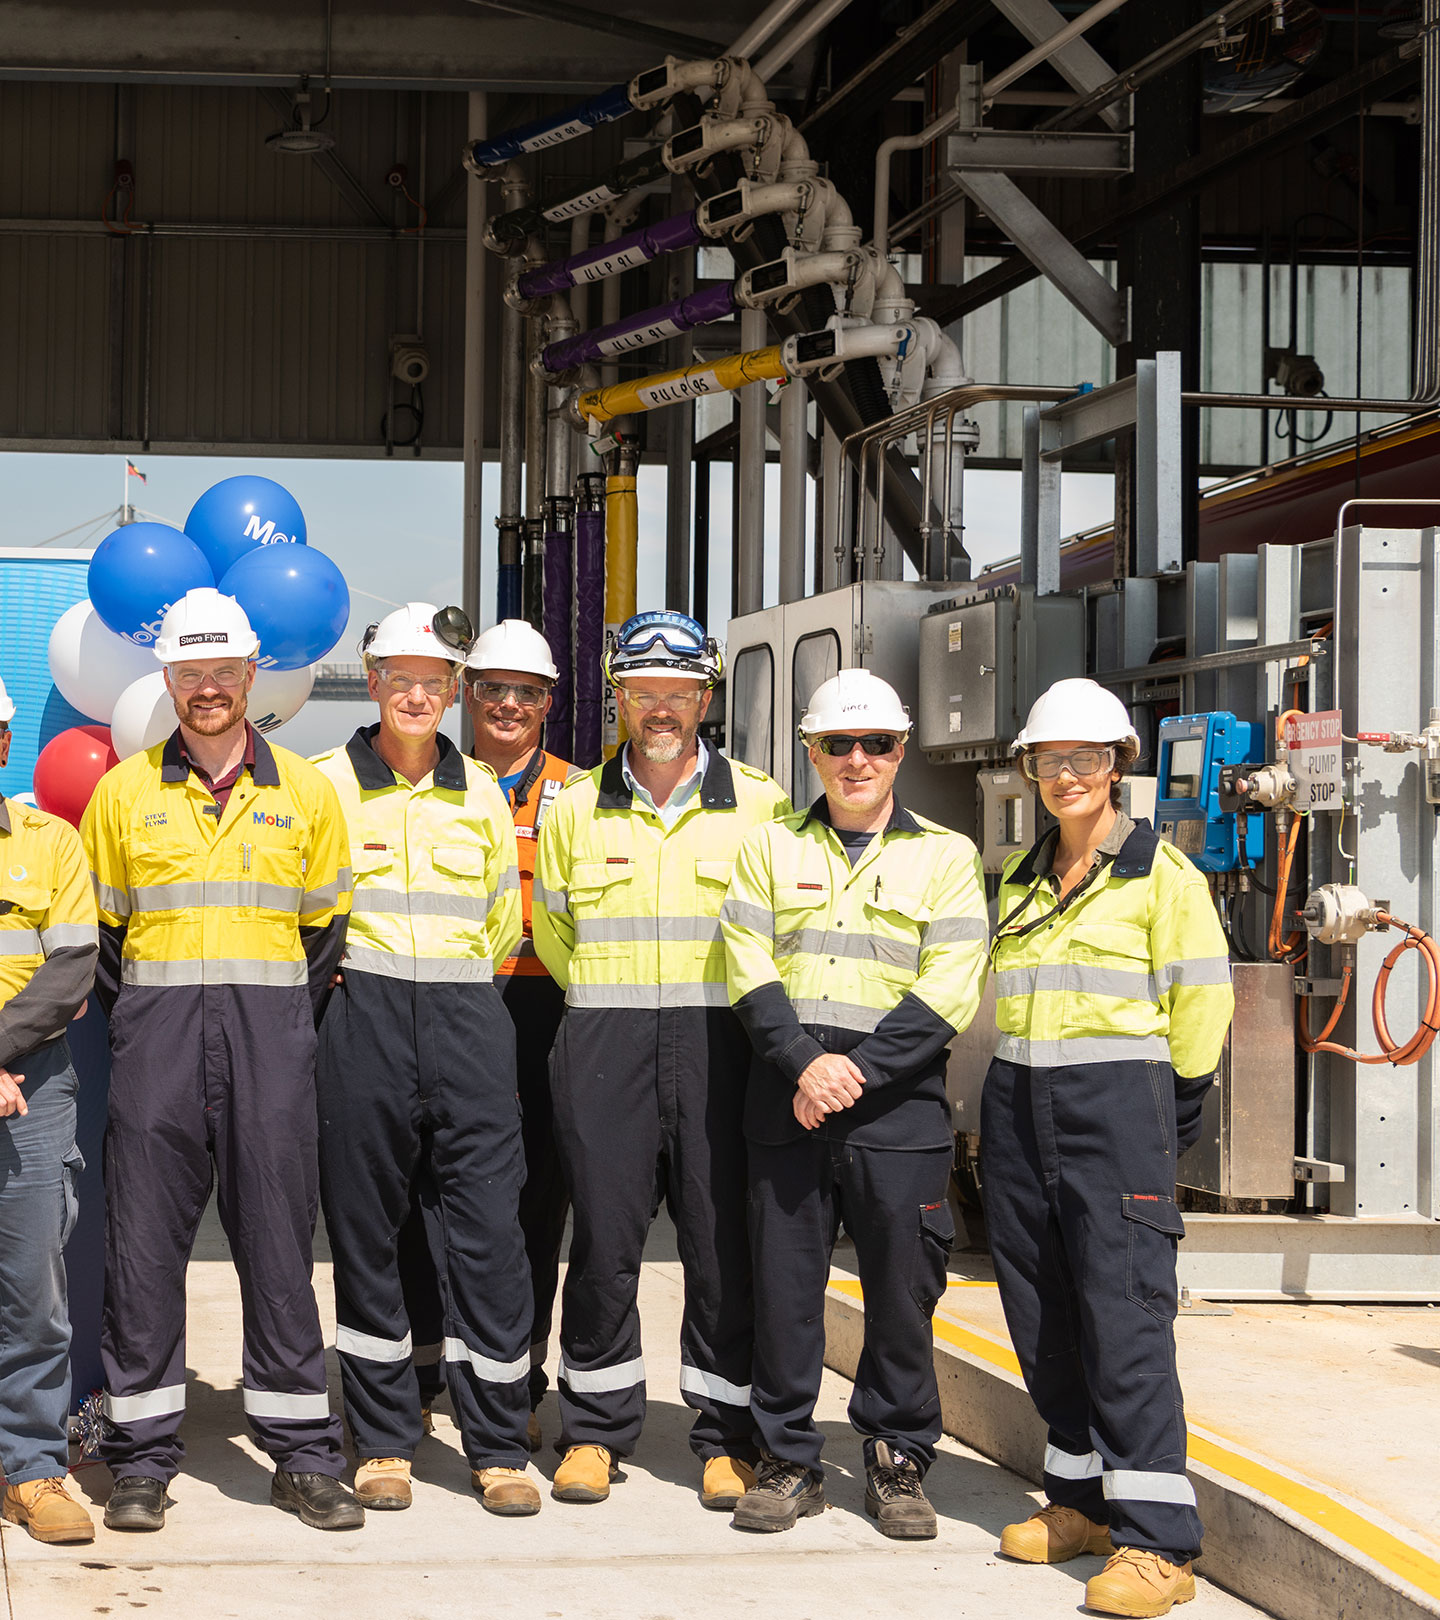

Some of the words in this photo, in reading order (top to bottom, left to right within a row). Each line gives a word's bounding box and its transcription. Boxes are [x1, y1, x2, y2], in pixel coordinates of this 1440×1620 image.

[584, 261, 613, 280] ULP
[617, 254, 634, 268] 91
[612, 333, 644, 351] ULP
[648, 326, 666, 339] 91
[650, 383, 689, 403] PULP
[693, 378, 710, 393] 95
[180, 635, 203, 645] Steve
[204, 633, 227, 643] Flynn
[1321, 718, 1340, 740] STOP
[1308, 753, 1337, 775] PUMP
[1310, 782, 1336, 803] STOP
[144, 811, 167, 821] STEVE
[144, 818, 168, 828] FLYNN
[252, 811, 292, 830] Mobil
